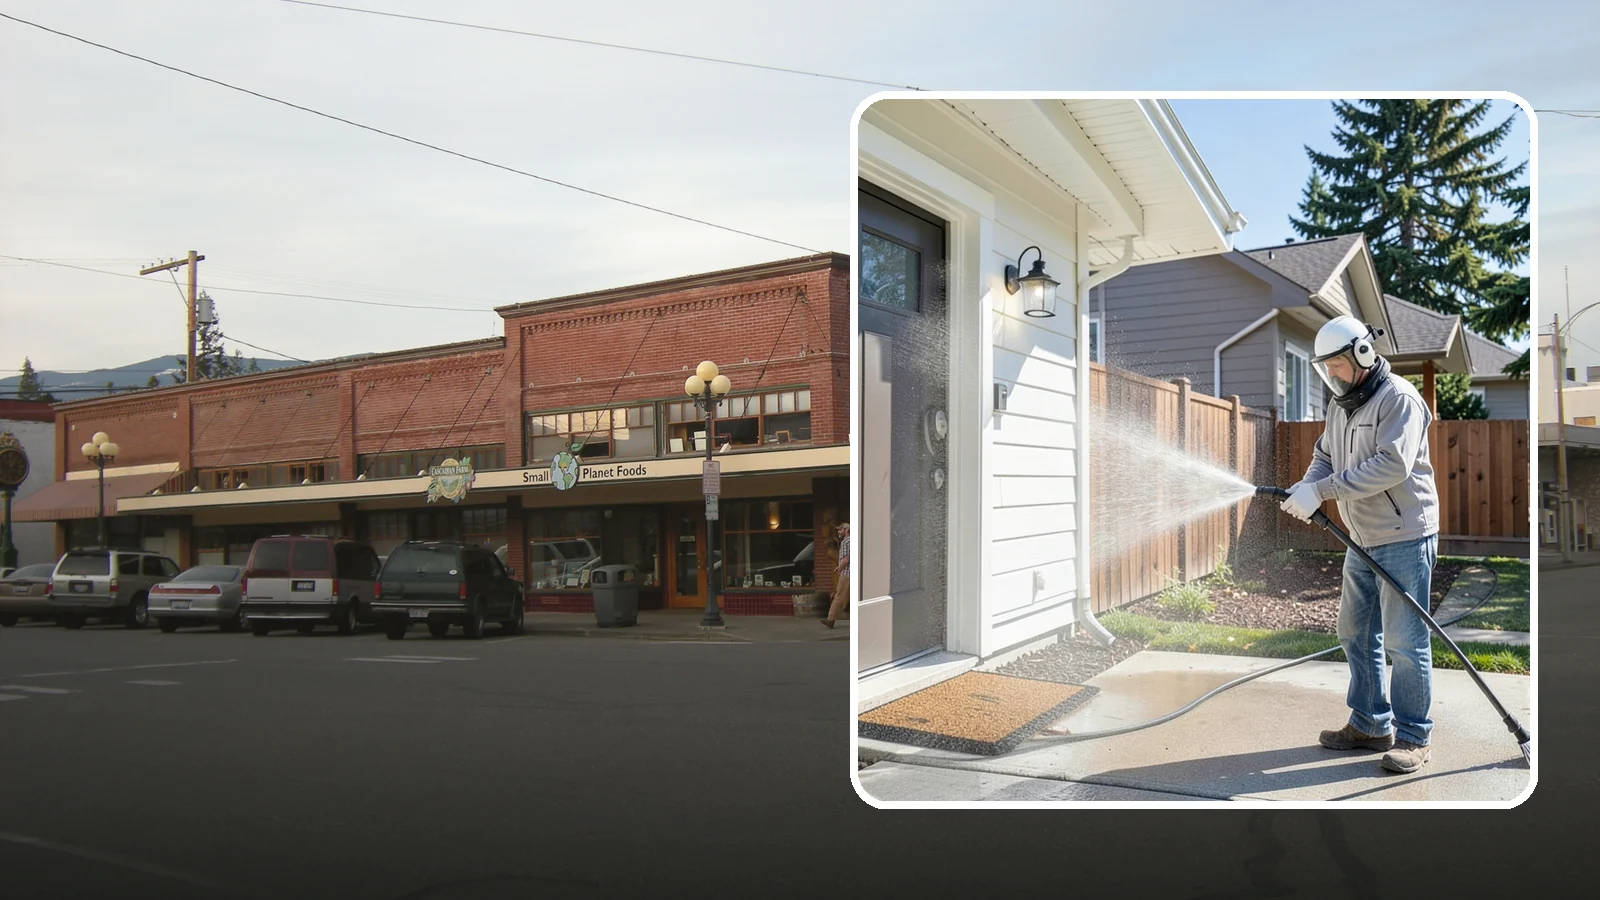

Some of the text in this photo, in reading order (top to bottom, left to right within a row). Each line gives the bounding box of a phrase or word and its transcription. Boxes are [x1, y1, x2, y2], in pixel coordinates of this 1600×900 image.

[523, 464, 647, 483] Small Planet Foods
